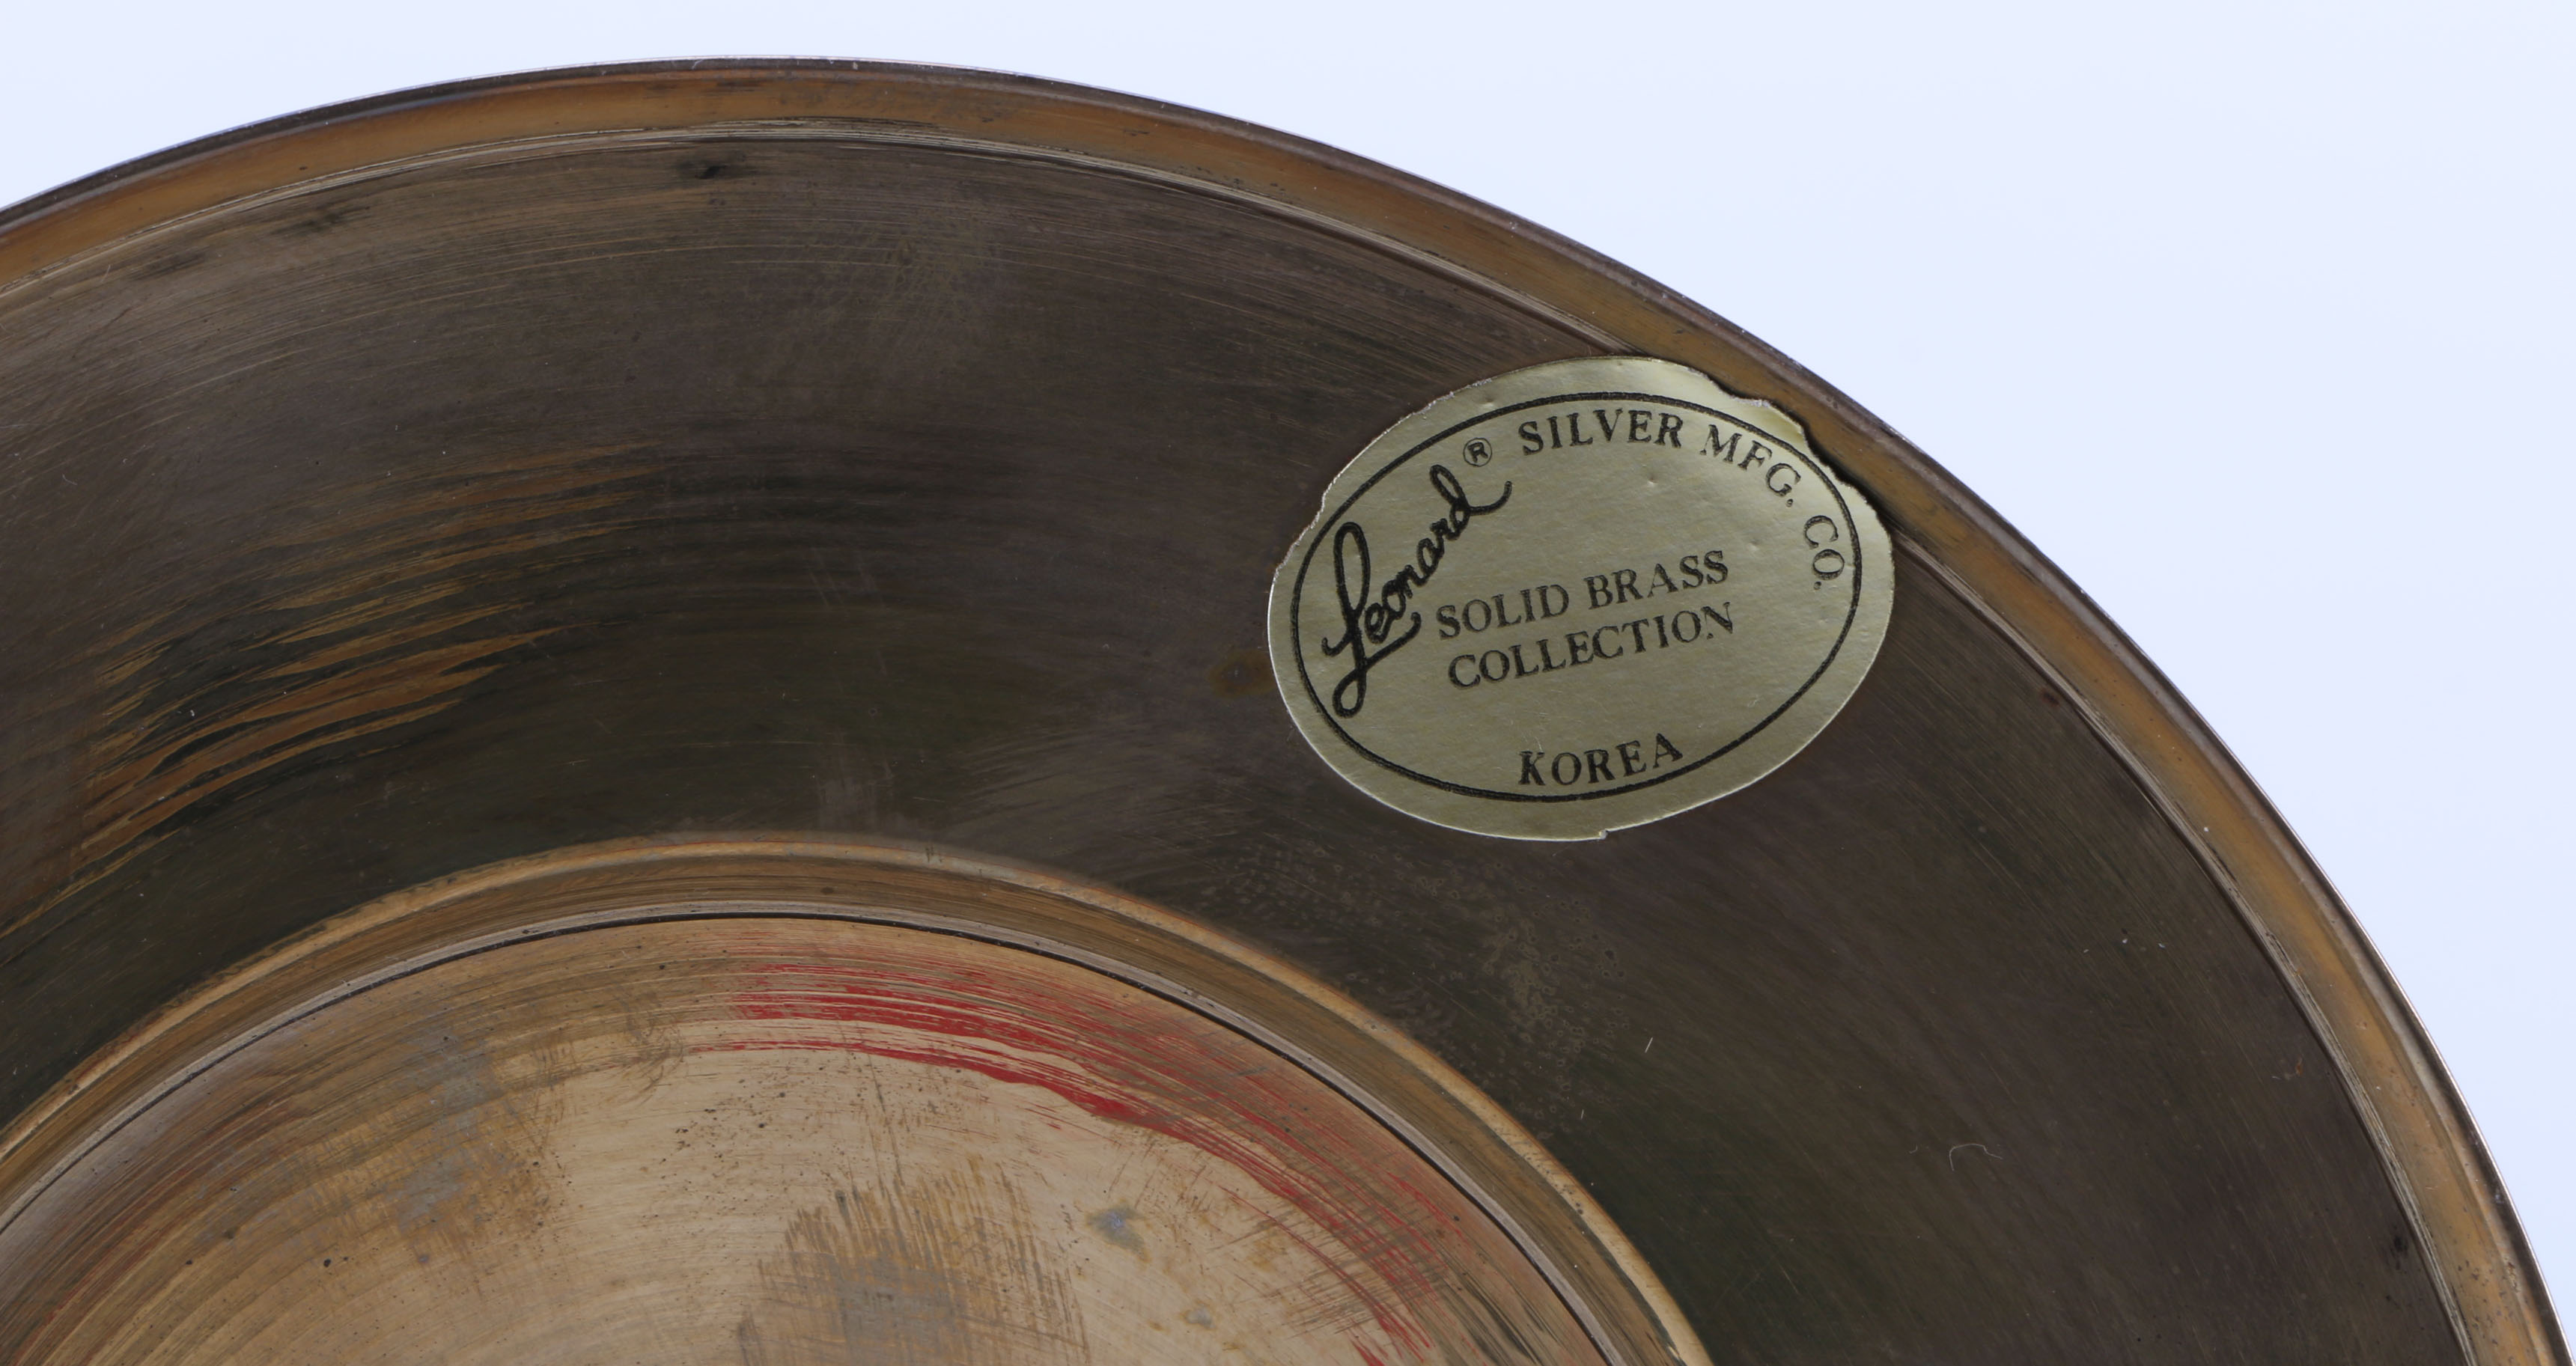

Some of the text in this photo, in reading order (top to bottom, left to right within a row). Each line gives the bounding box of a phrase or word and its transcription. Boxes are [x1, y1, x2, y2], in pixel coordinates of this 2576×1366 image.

[1518, 408, 1845, 590] SILVER MFG. CO.
[1321, 464, 1512, 719] Leonard
[1437, 550, 1729, 639] SOLID BRASS
[1448, 603, 1735, 689] COLLECTION
[1517, 732, 1684, 787] KOREA
